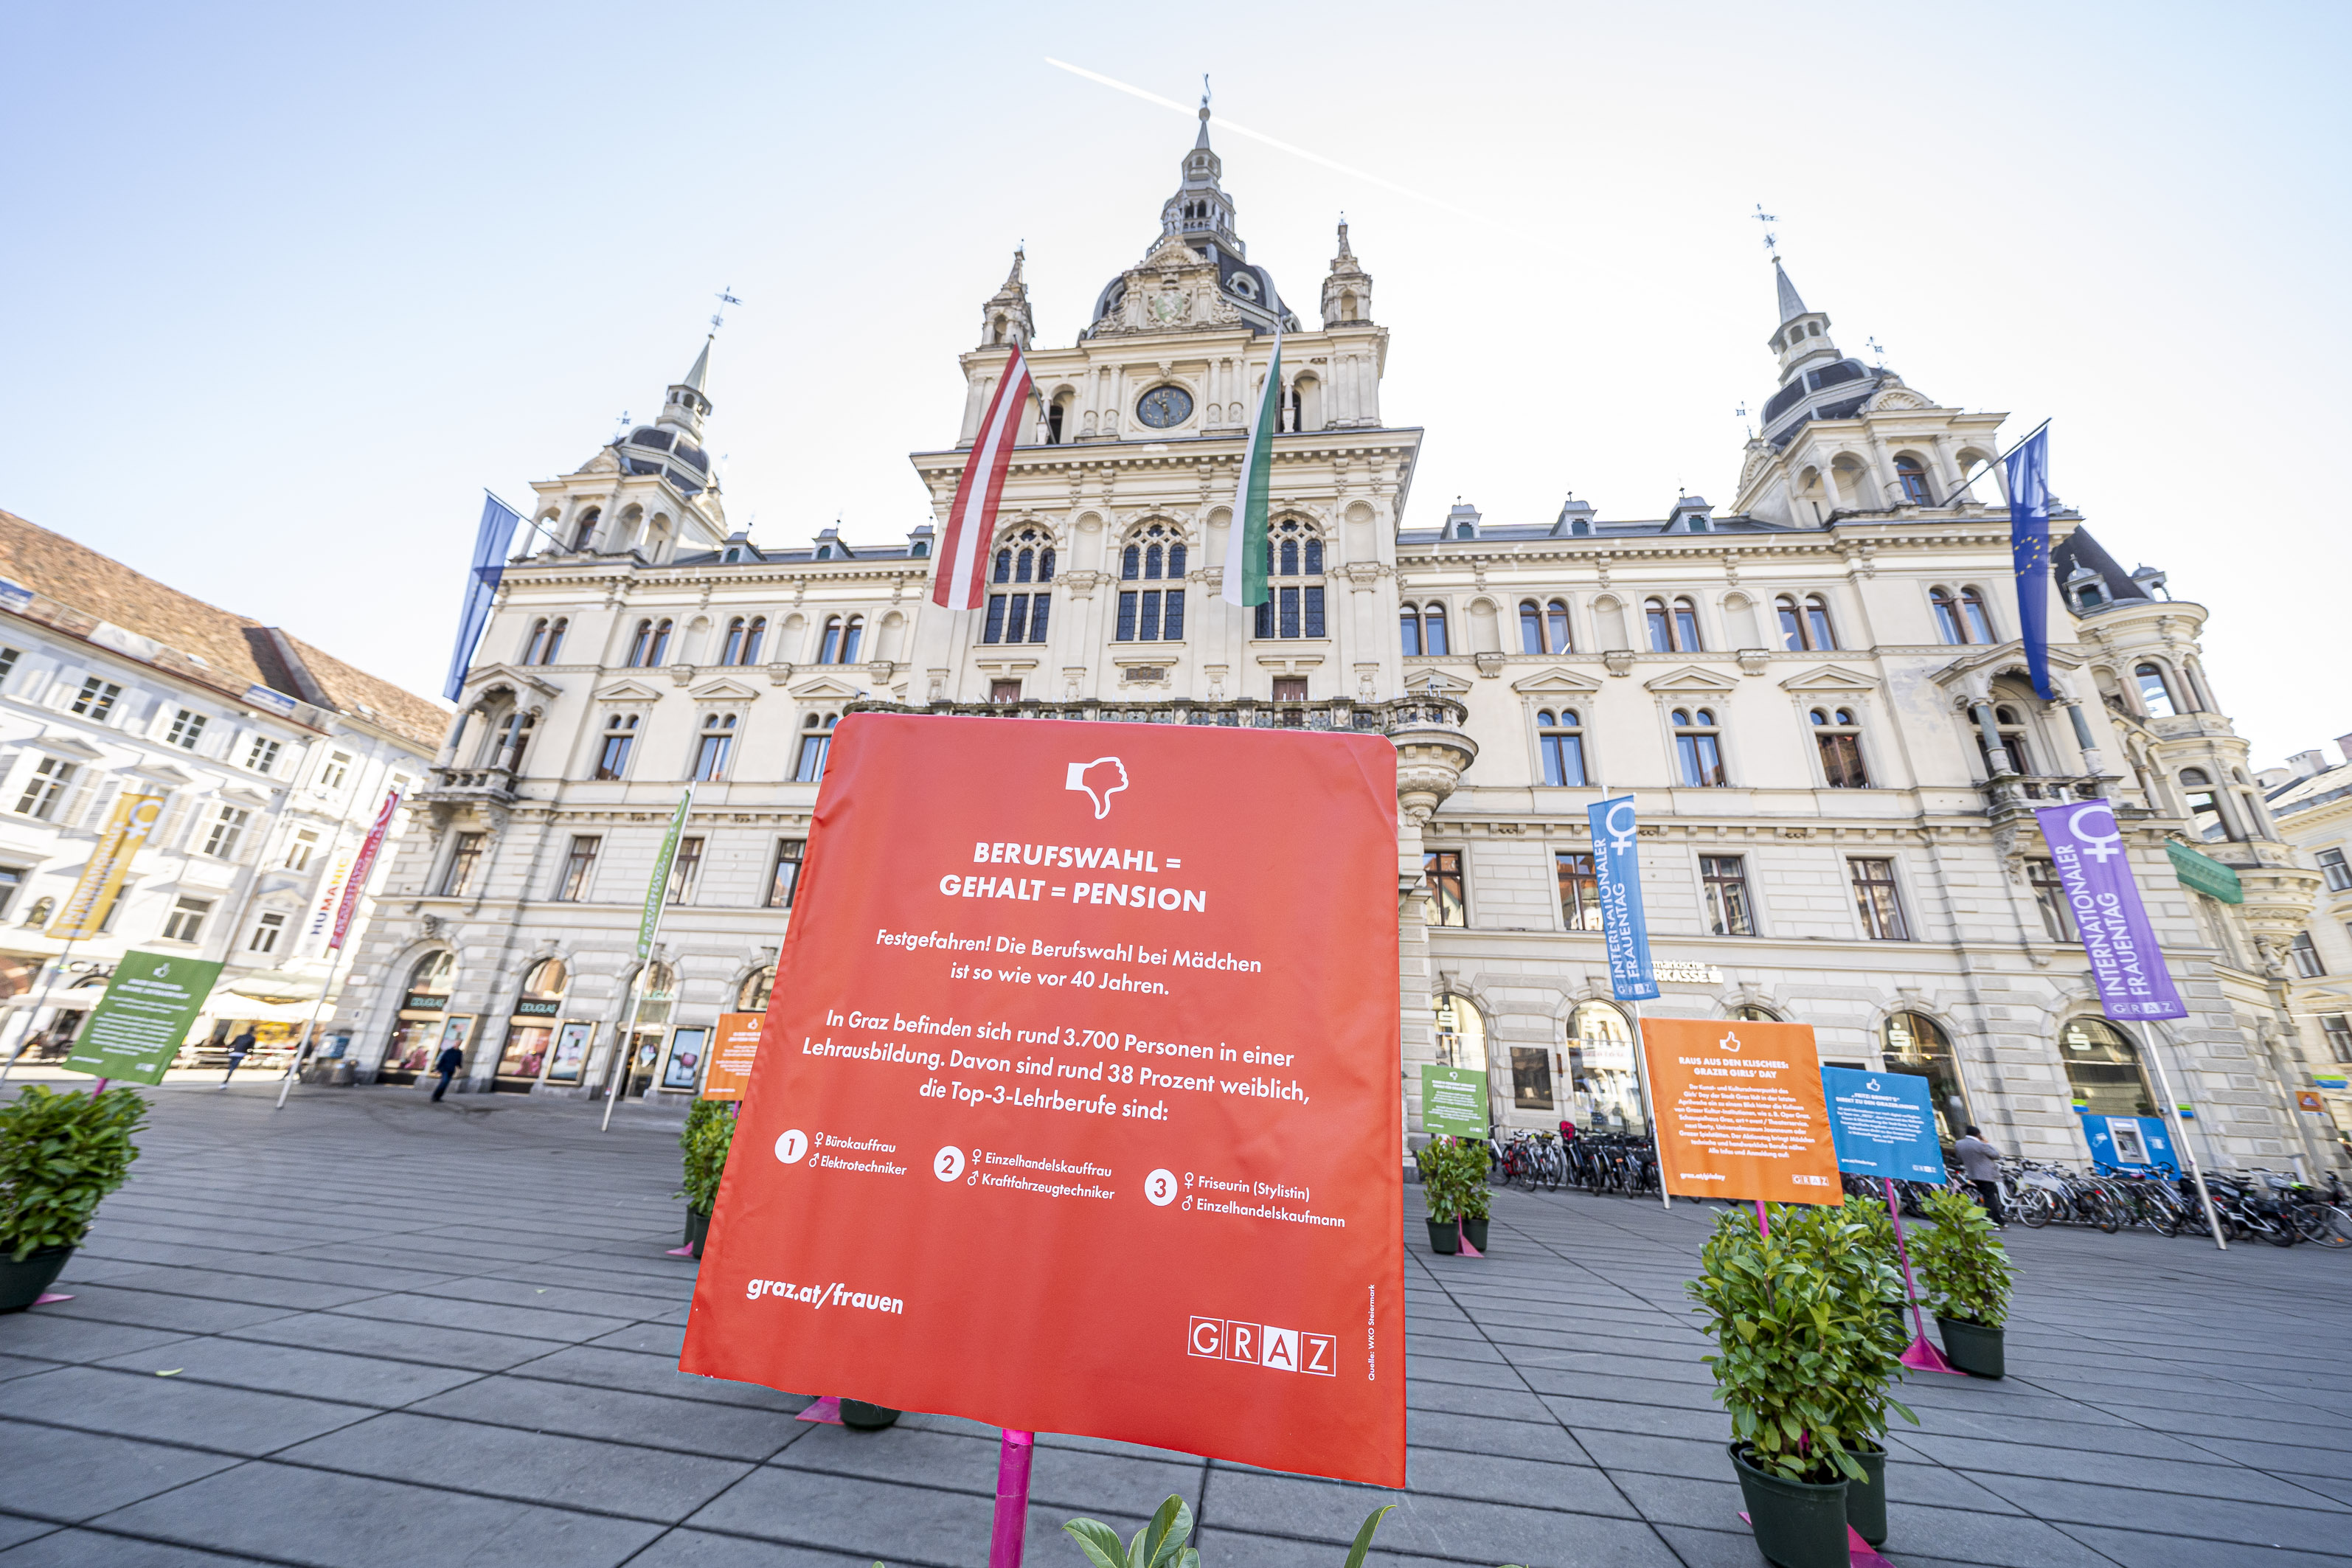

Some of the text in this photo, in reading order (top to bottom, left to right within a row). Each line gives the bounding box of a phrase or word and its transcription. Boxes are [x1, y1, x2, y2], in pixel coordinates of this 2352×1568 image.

[973, 842, 1182, 873] BERUFSWAHL =
[310, 858, 352, 934] HUMANIC
[939, 875, 1207, 913] GEHALT = PENSION
[1612, 882, 1640, 979] FRAUENTAG
[2055, 844, 2127, 996] INTERNATIONALER
[876, 929, 1261, 973] Festgefahren! Die Berufswahl bei Mädchen
[2096, 892, 2151, 996] FRAUENTAG
[1652, 960, 1706, 970] märkische
[1653, 968, 1708, 982] RKASSE
[950, 965, 1169, 996] ist so wie vor 40 Jahren.
[1617, 982, 1654, 996] GRAZ
[410, 996, 446, 1007] DOUGLAS
[520, 1002, 557, 1014] DOUGLAS
[2111, 1002, 2176, 1014] GRAZ
[826, 1010, 1294, 1067] In Graz befinden sich rund 3.700 Personen in einer
[802, 1037, 1310, 1106] Lehrausbildung. Davon sind rund 38 Prozent weiblich,
[1679, 1056, 1789, 1069] RAUS AUS DEN KLISCHEES:
[1693, 1067, 1729, 1077] GRAZER
[1758, 1070, 1777, 1079] DAY
[919, 1078, 1168, 1121] die Top-3-Lehrberufe sind:
[788, 1135, 896, 1155] 1 Bürokauffrau
[820, 1156, 907, 1176] Elektrotechniker
[941, 1152, 1112, 1177] 2 Einzelhandelskauffrau
[982, 1173, 1115, 1199] Kraftfahrzeugtechniker
[1154, 1176, 1310, 1203] 3 Friseurin (Stylistin)
[1793, 1175, 1829, 1186] GRAZ
[1196, 1198, 1345, 1228] Einzelhandelskaufmann
[746, 1280, 903, 1315] graz.at/frauen
[1189, 1318, 1333, 1374] GRAZ
[1367, 1284, 1376, 1381] Quelle: WKO Steiermark
